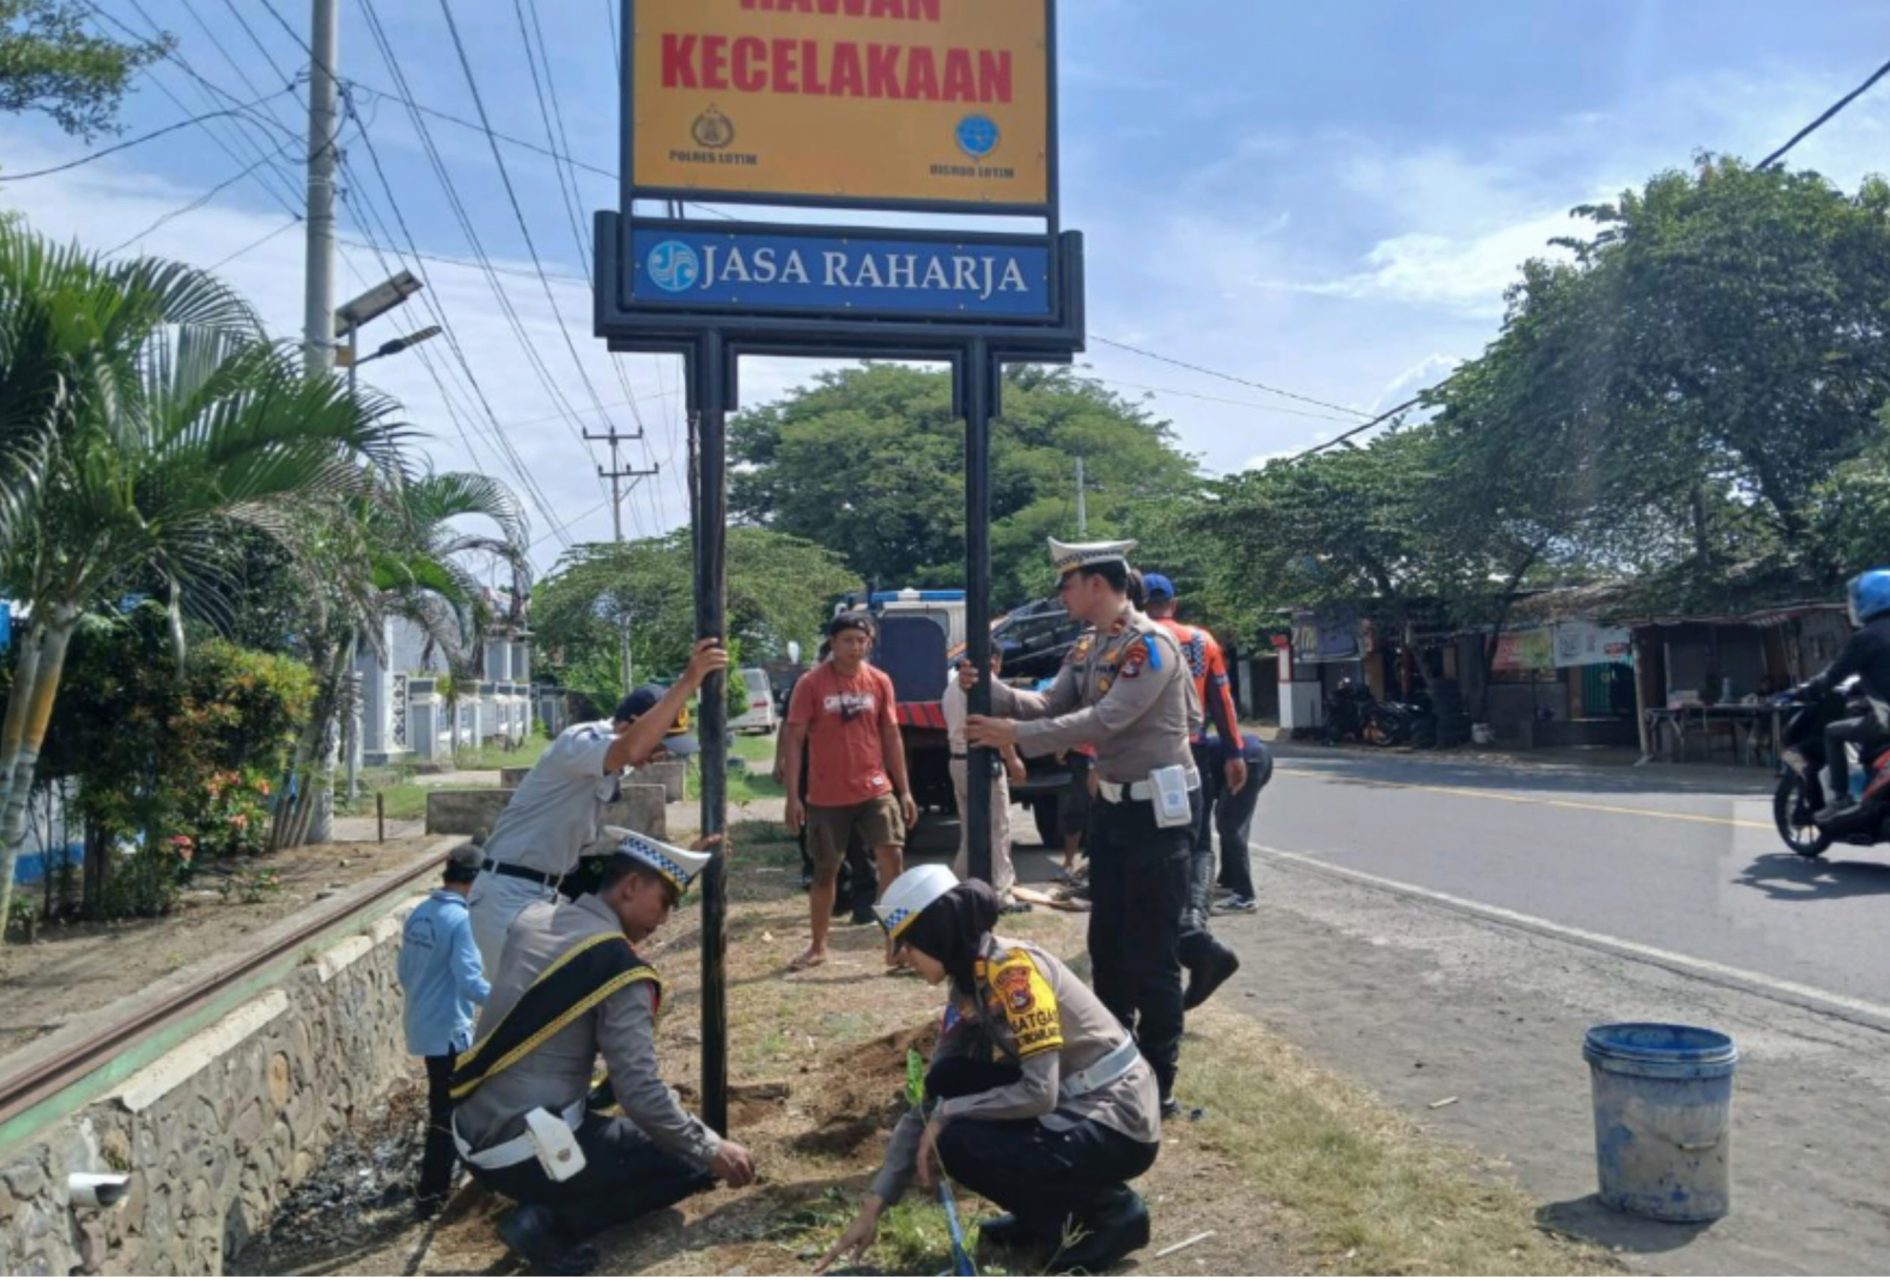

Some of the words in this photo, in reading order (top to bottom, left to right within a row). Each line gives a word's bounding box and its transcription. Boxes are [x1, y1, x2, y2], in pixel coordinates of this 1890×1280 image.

[660, 33, 1013, 104] KECELAKAAN
[700, 245, 811, 289] JASA
[821, 250, 1029, 299] RAHARJA
